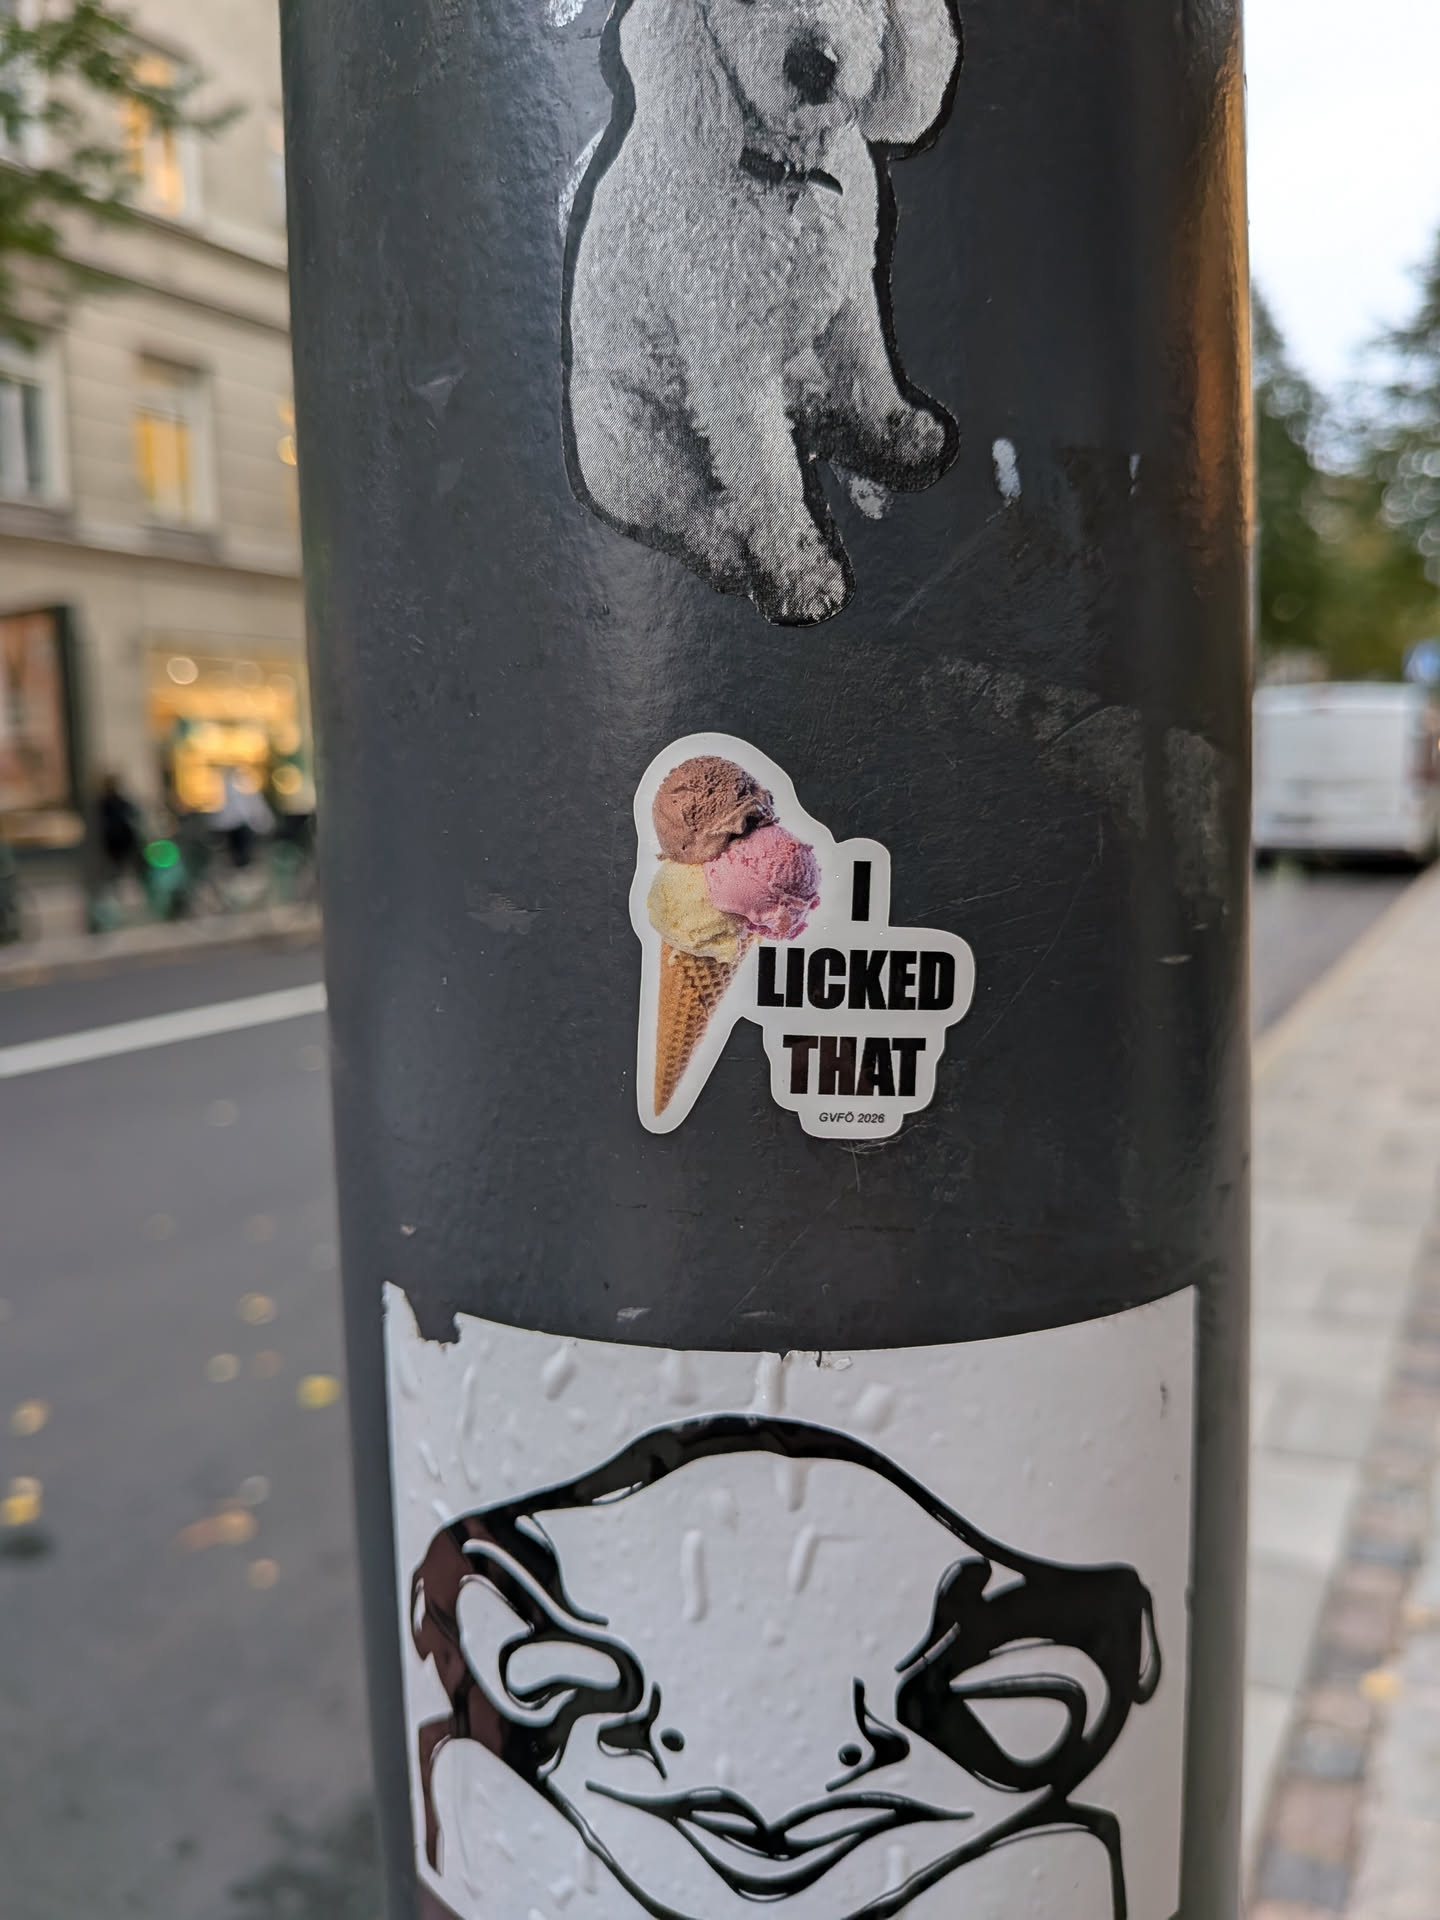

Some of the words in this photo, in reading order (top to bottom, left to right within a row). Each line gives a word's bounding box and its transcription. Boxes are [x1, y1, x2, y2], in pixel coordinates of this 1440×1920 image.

[851, 860, 872, 922] I
[756, 946, 956, 1011] LICKED
[782, 1034, 927, 1097] THAT
[818, 1111, 855, 1123] GVFÖ
[857, 1112, 886, 1124] 2026
